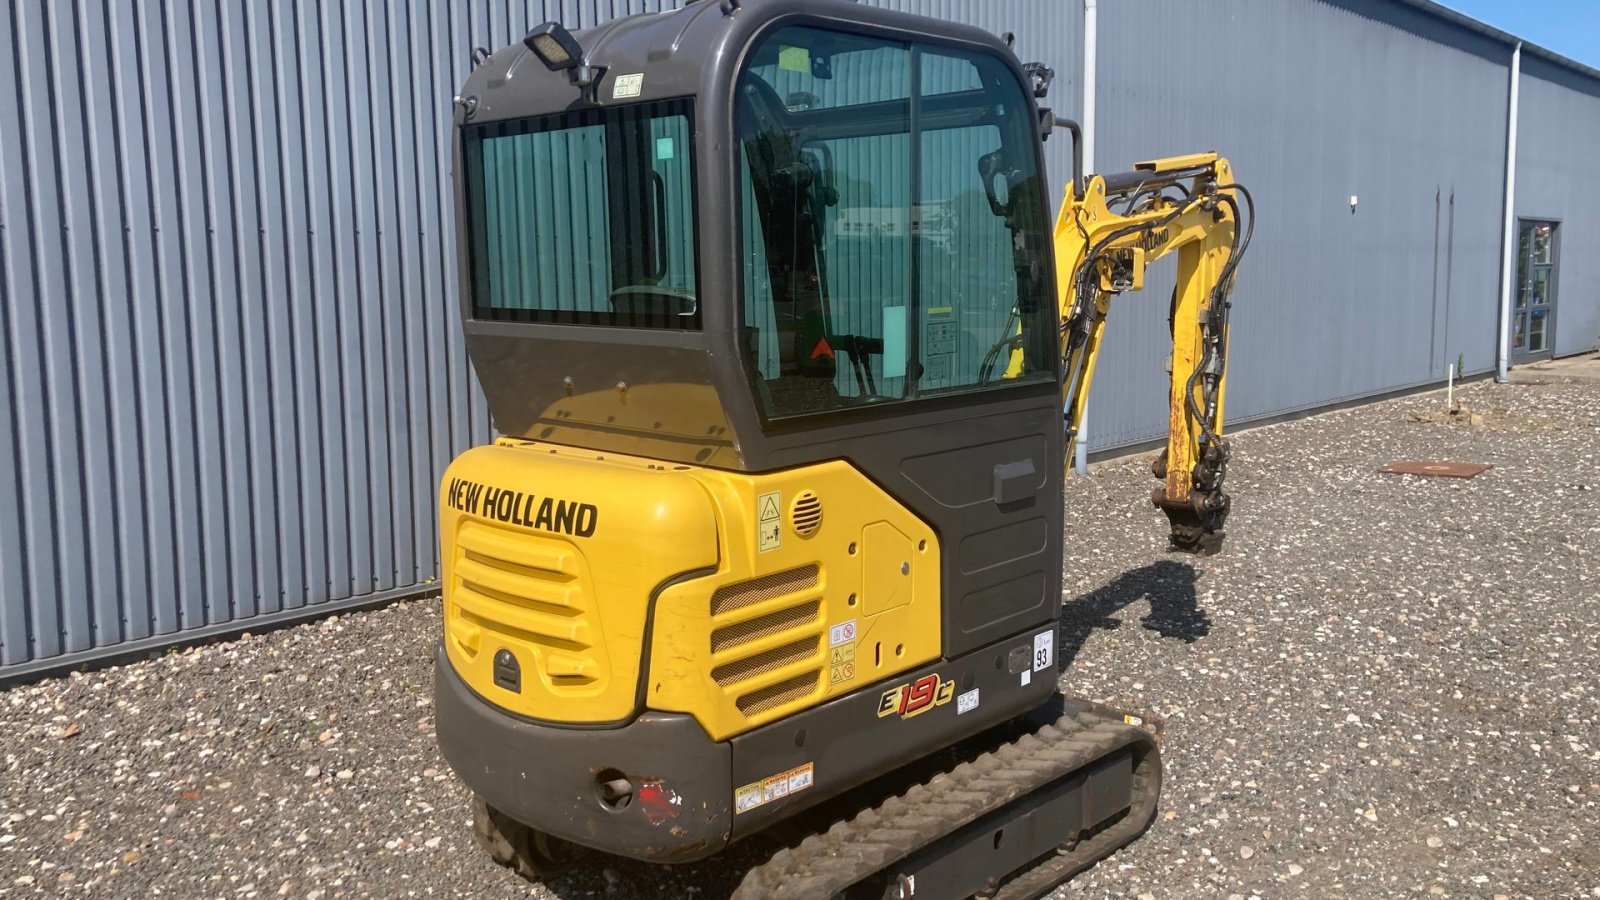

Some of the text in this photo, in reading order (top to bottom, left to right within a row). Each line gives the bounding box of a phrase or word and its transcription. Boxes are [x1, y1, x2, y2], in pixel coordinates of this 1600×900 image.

[448, 477, 598, 538] NEW HOLLAND
[1036, 648, 1047, 667] 93
